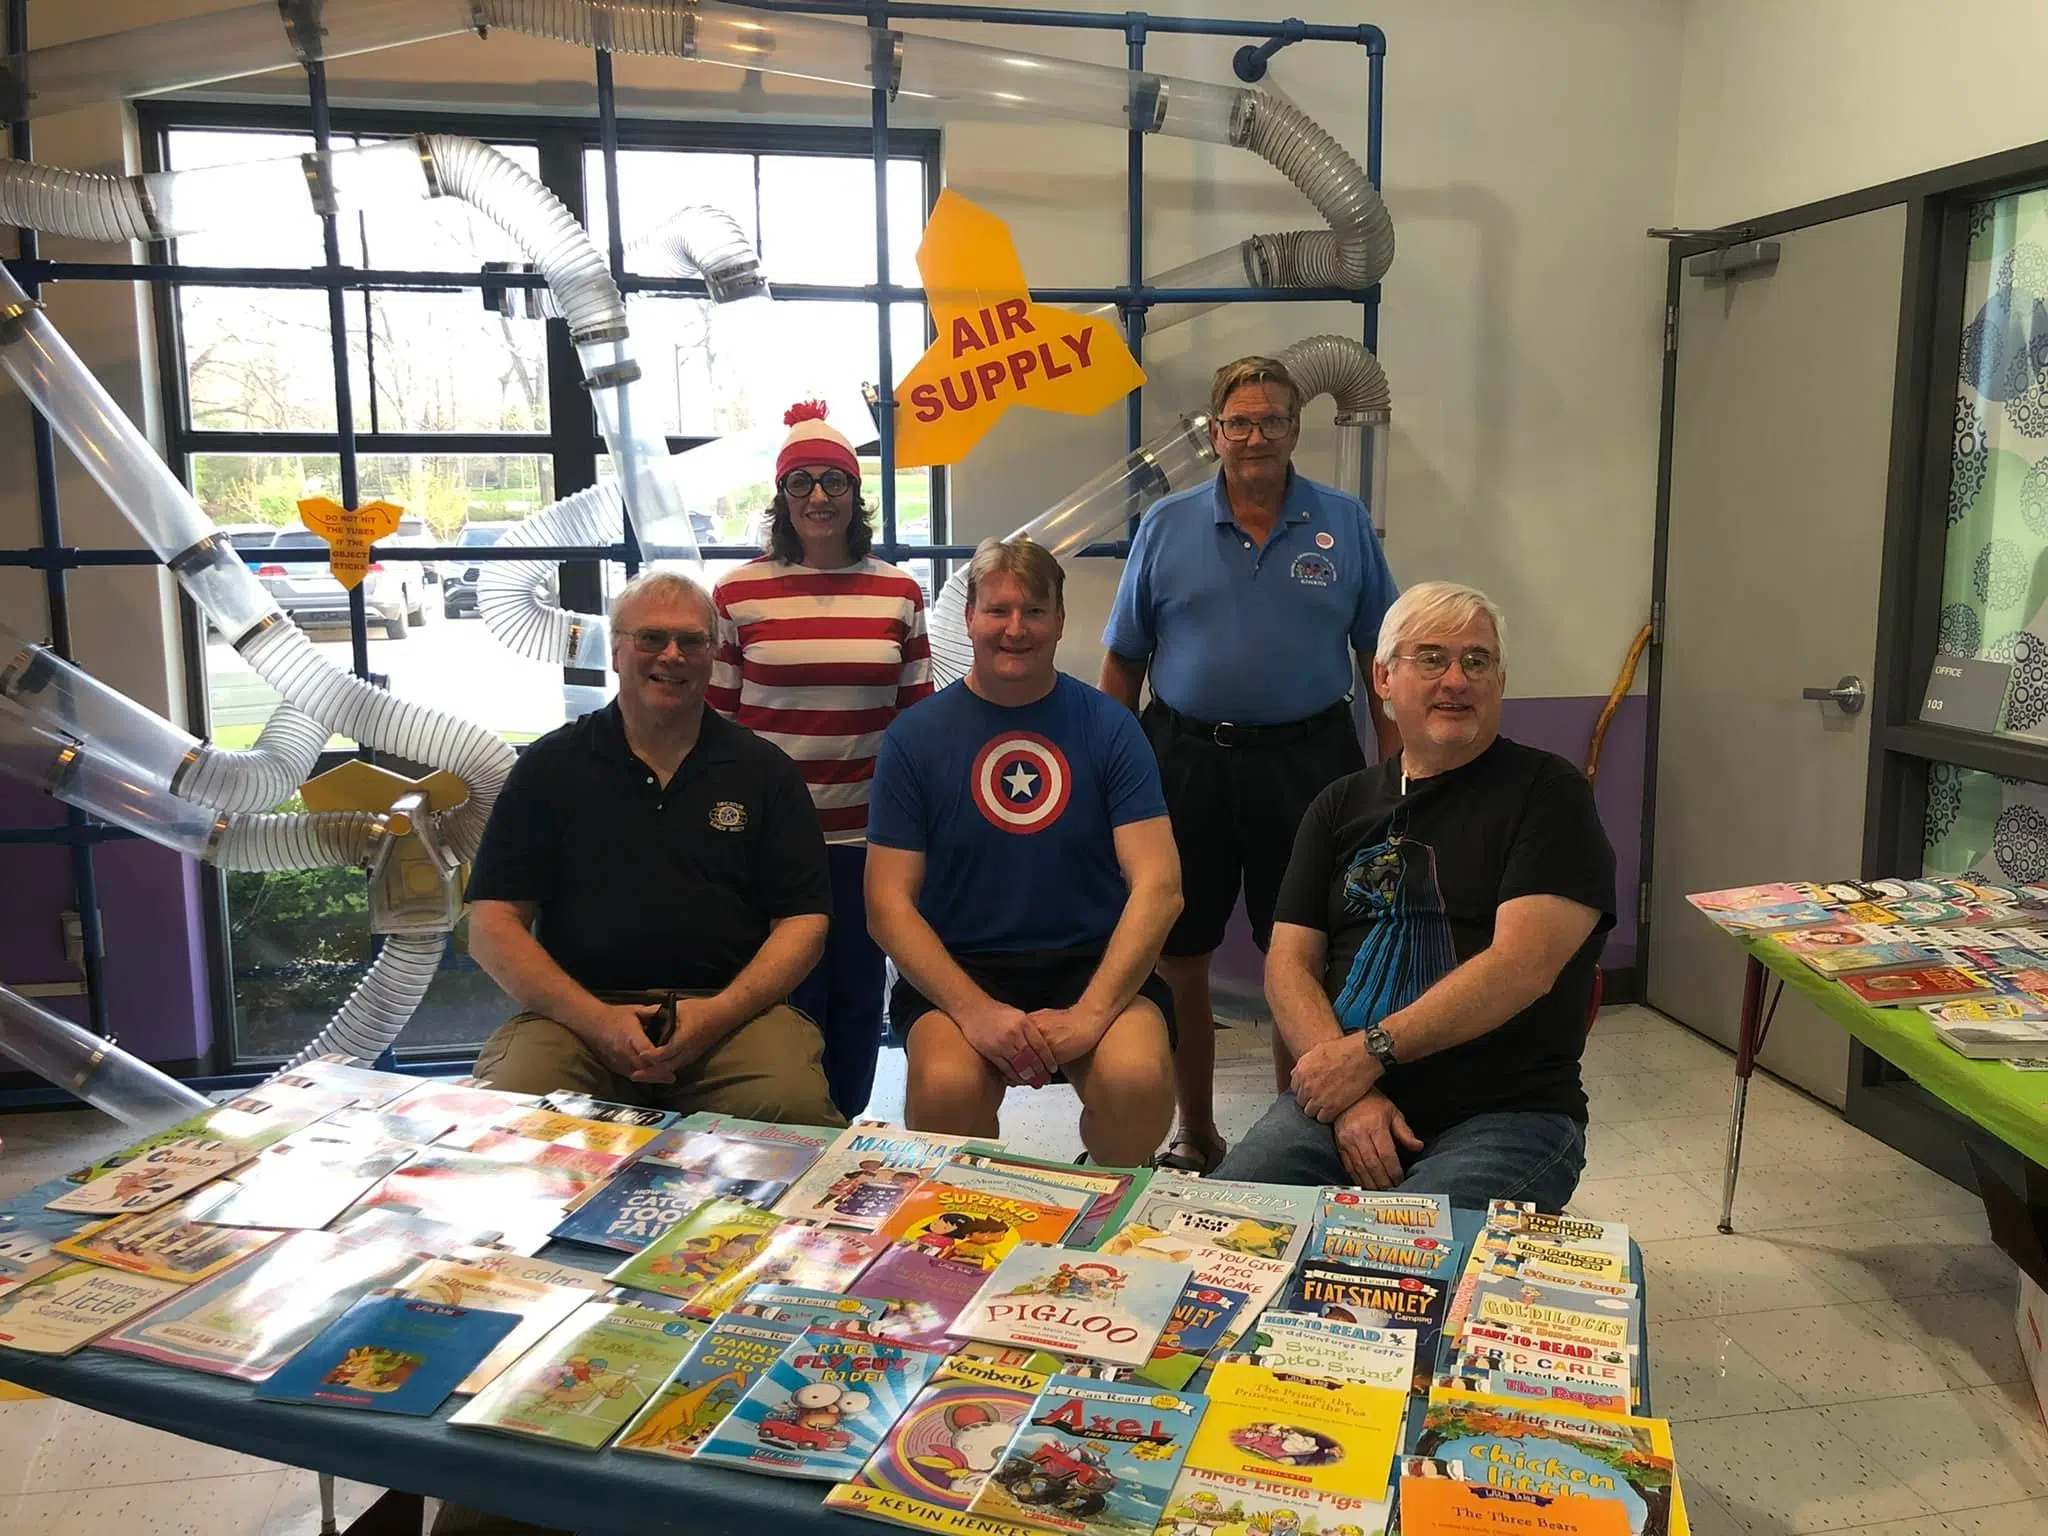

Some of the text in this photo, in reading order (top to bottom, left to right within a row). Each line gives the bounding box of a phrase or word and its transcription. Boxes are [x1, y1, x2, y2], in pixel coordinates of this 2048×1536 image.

[953, 298, 1036, 359] AIR
[910, 327, 1094, 423] SUPPLY
[361, 516, 376, 524] HIT
[326, 526, 375, 536] THE TUBES
[347, 539, 364, 547] THE
[332, 550, 368, 559] OBJECT
[1935, 666, 1964, 677] OFFICE
[1927, 699, 1944, 710] 103
[146, 1149, 222, 1167] Cowboy
[1176, 1186, 1299, 1210] Tooth Fairy
[1528, 1216, 1604, 1233] The Little
[1529, 1223, 1603, 1240] Red Hen
[1197, 1248, 1287, 1273] IF YOU GIVE
[1323, 1235, 1365, 1257] FLAT
[1364, 1242, 1447, 1270] STANLEY
[1516, 1241, 1613, 1266] The Princess
[1210, 1263, 1253, 1279] A PIG
[1570, 1259, 1604, 1272] Pea
[521, 1268, 583, 1286] color
[1194, 1272, 1265, 1294] PANCAKE
[1523, 1268, 1627, 1296] Stone Soup
[51, 1288, 138, 1315] Little
[1304, 1281, 1346, 1303] FLAT
[1348, 1285, 1434, 1314] STANLEY
[986, 1304, 1138, 1344] PIGLOO
[1395, 1313, 1433, 1325] Camping
[1483, 1300, 1624, 1336] GOLDILOCKS
[742, 1327, 766, 1336] Can
[770, 1332, 794, 1341] Rea
[1264, 1315, 1382, 1342] READY-TO-READ
[710, 1335, 783, 1356] DANNY
[1286, 1331, 1357, 1349] adventures
[1472, 1326, 1593, 1359] READY-TO-READ
[701, 1355, 754, 1373] Go to
[793, 1355, 914, 1371] FLY GUY
[1328, 1361, 1404, 1383] Swing!
[1537, 1359, 1618, 1379] CARLE
[821, 1370, 886, 1383] RIDE!
[1075, 1391, 1102, 1400] Can
[1107, 1394, 1145, 1404] Read!
[1255, 1383, 1280, 1395] The
[1331, 1397, 1352, 1407] the
[1504, 1379, 1549, 1396] The
[1292, 1398, 1317, 1409] and
[1321, 1401, 1342, 1413] the
[1346, 1407, 1367, 1417] Pea
[1508, 1412, 1623, 1438] Little Red Hen
[1106, 1433, 1139, 1442] TRUCK
[1468, 1442, 1616, 1492] chicken
[1189, 1469, 1248, 1487] Three
[1253, 1480, 1310, 1499] Little
[1318, 1492, 1363, 1511] Pigs
[851, 1490, 873, 1503] by
[880, 1497, 944, 1522] KEVIN
[950, 1515, 1031, 1536] HENKES
[1452, 1506, 1483, 1520] The
[1487, 1510, 1533, 1528] Three
[1536, 1518, 1578, 1533] Bears
